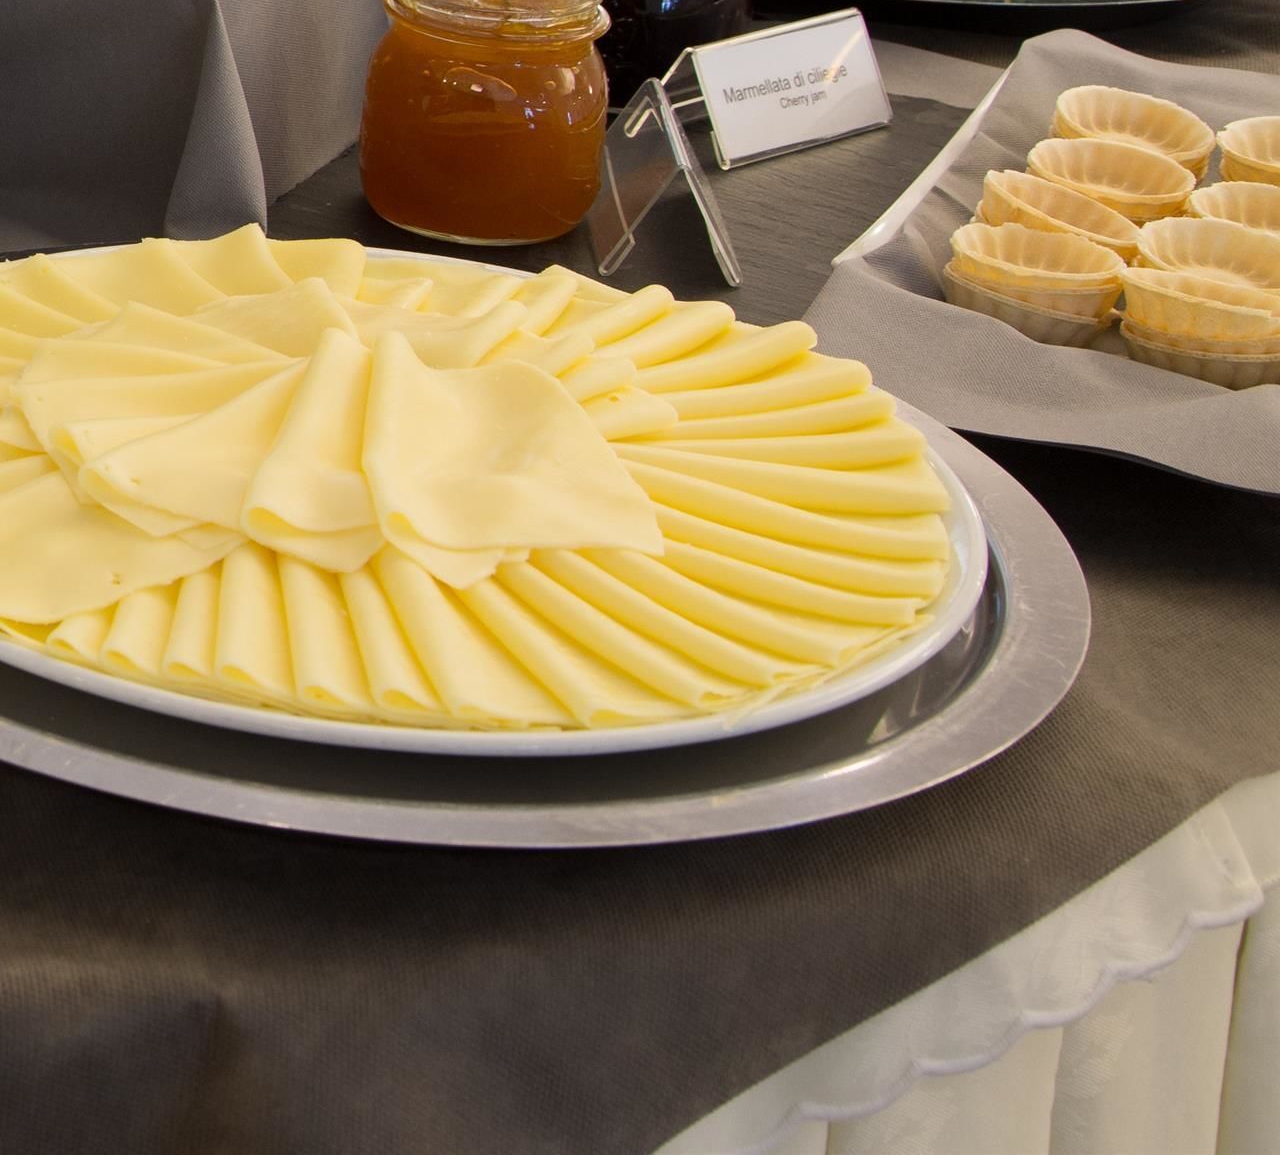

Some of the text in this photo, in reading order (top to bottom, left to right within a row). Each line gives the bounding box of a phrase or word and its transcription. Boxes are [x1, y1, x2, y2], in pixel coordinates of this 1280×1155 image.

[723, 64, 848, 104] Marmellata di ciliegie
[780, 90, 827, 109] Cherry jam
